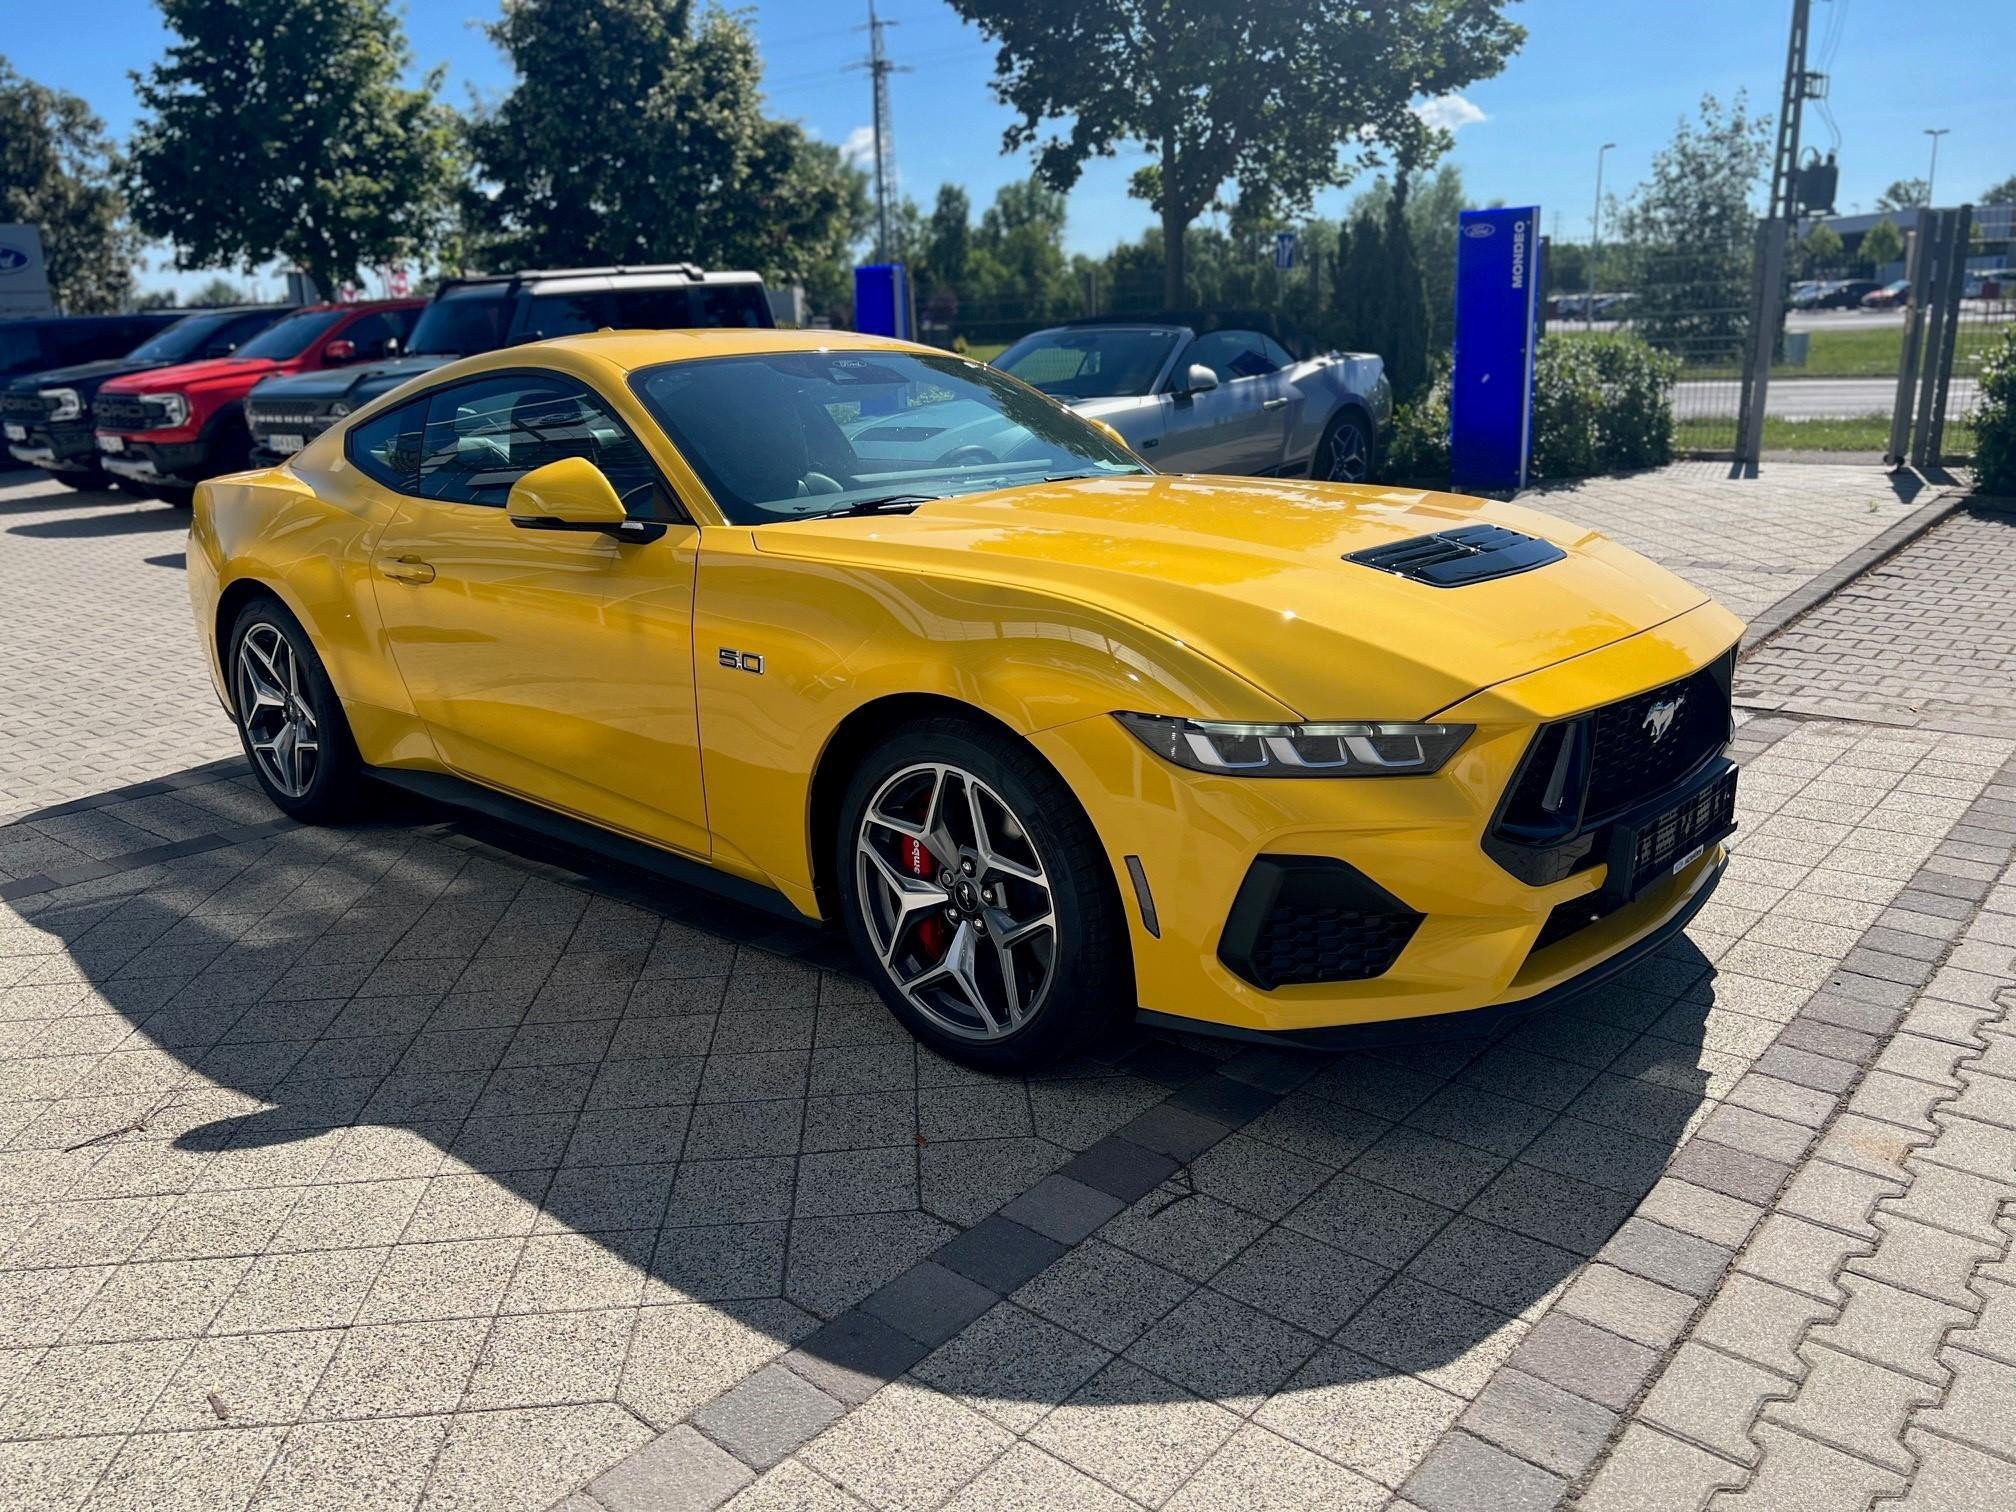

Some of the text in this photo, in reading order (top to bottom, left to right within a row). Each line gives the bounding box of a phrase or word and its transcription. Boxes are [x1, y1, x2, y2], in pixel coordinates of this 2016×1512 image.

[1512, 221, 1525, 289] MONDEO
[719, 647, 764, 675] 5.0
[912, 839, 921, 874] embo
